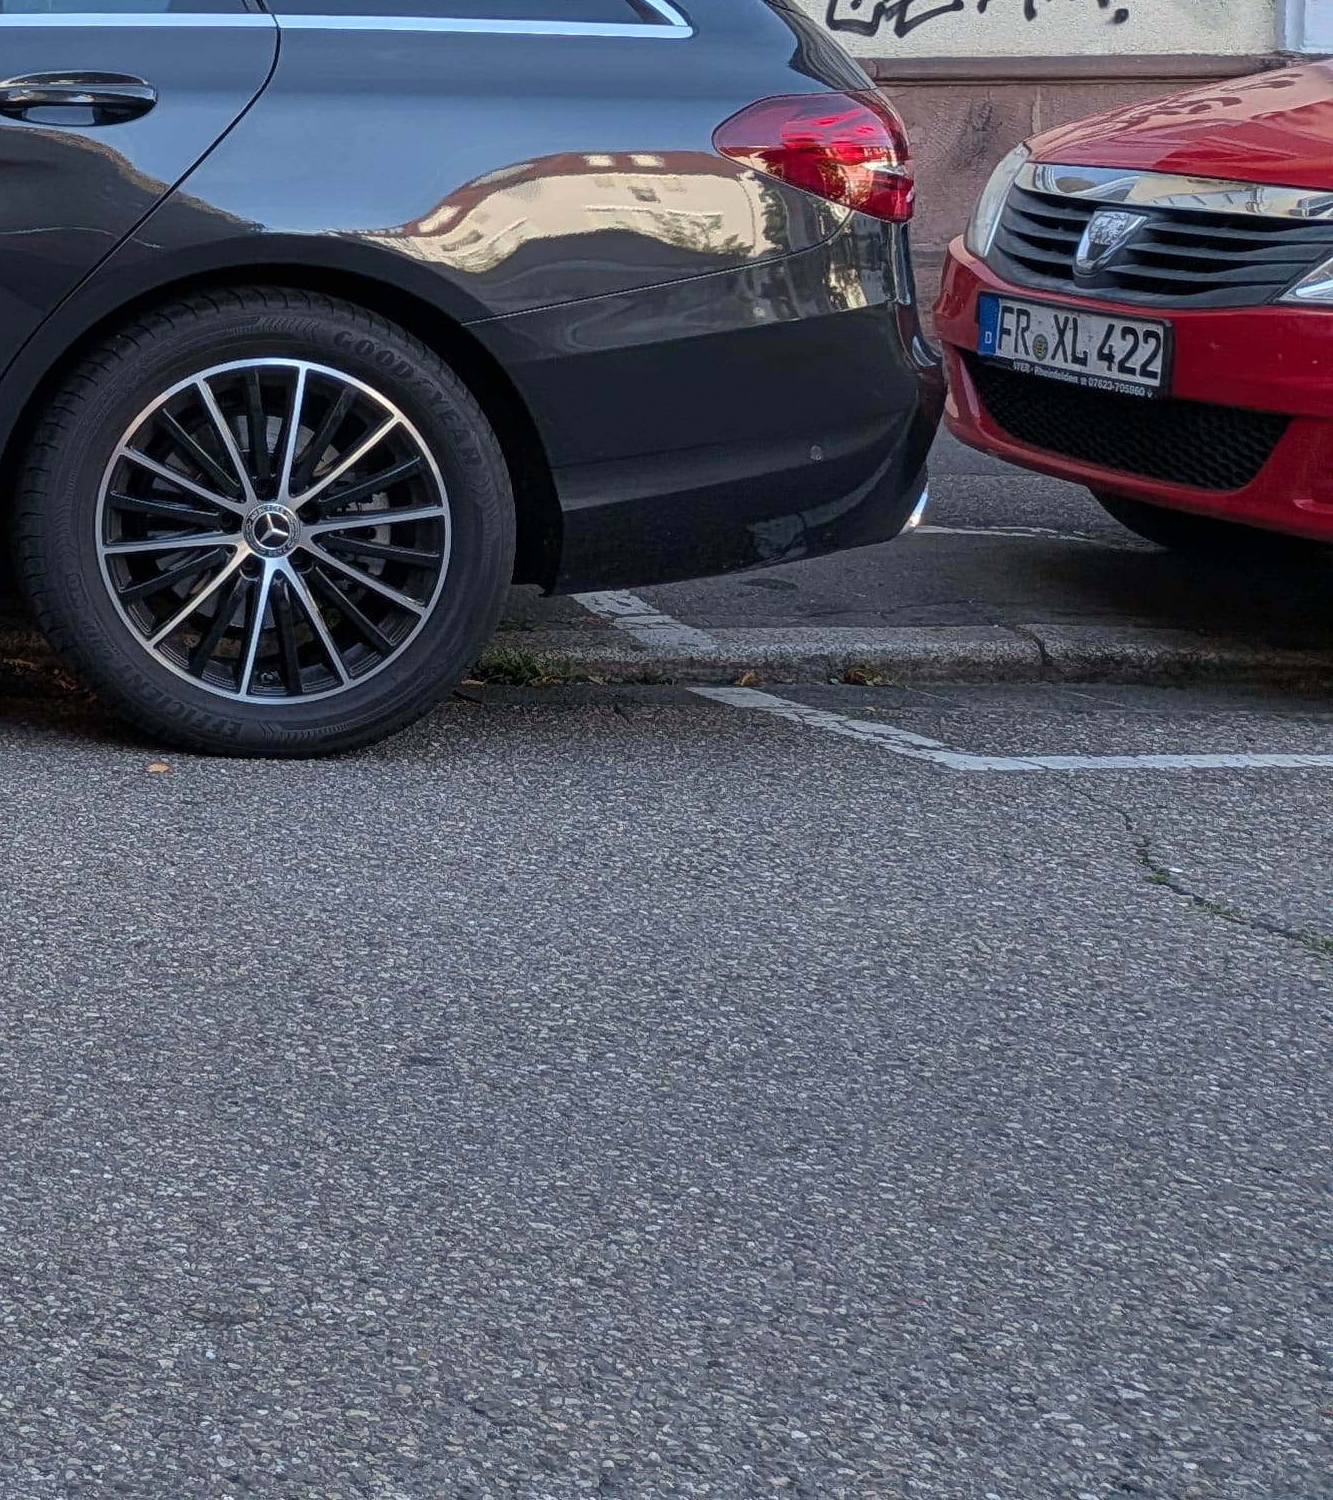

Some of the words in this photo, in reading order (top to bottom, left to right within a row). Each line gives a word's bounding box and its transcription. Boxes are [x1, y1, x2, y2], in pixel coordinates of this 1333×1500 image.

[984, 331, 993, 345] D
[997, 305, 1031, 357] FR
[1051, 314, 1088, 367] XL
[1097, 323, 1162, 381] 422
